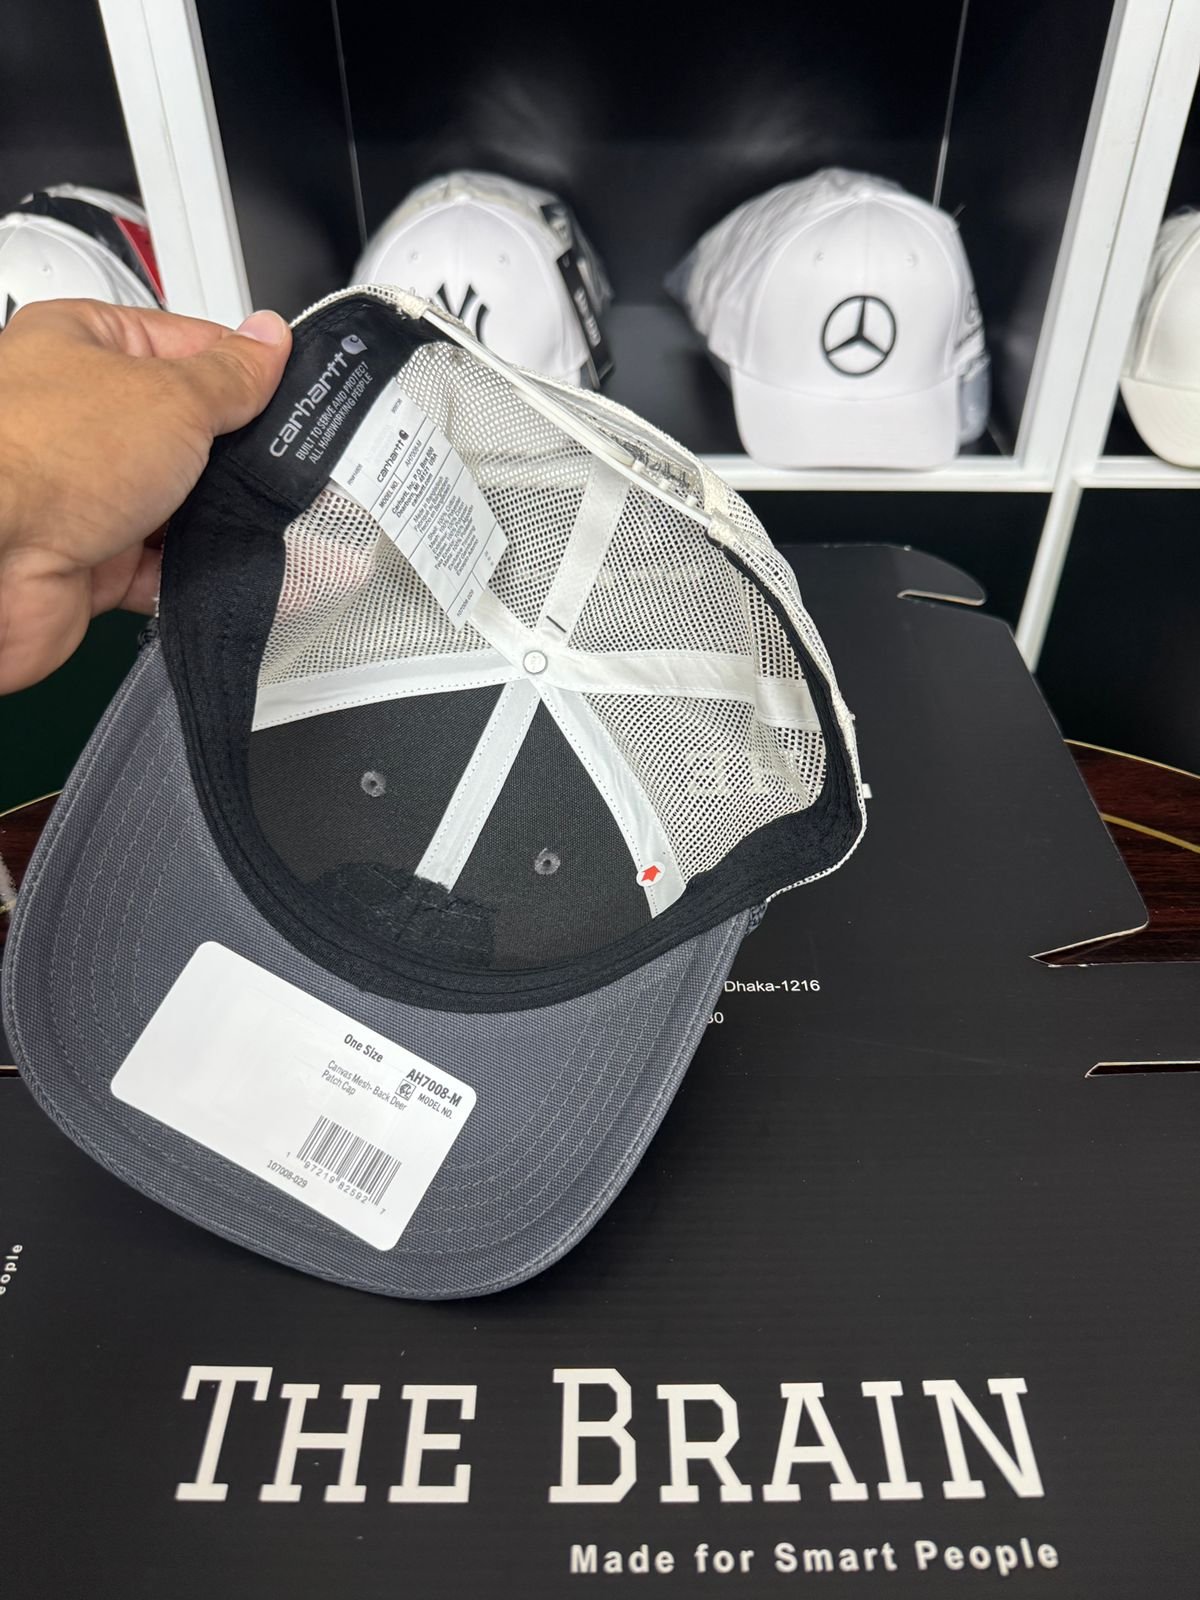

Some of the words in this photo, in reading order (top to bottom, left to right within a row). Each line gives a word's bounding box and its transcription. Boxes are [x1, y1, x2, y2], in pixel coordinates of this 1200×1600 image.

[270, 352, 348, 457] carhartt
[296, 437, 315, 460] BUILT
[310, 427, 322, 438] TO
[317, 405, 336, 429] SERVE
[332, 391, 347, 409] AND
[343, 362, 368, 393] PROTECT
[309, 449, 323, 464] ALL
[318, 398, 355, 449] HARDWORKING
[351, 372, 372, 400] PEOPLE
[377, 440, 404, 482] carhartt
[413, 469, 425, 481] P.O.
[420, 457, 428, 469] Box
[429, 453, 437, 466] USA
[413, 483, 420, 491] MI
[416, 466, 429, 482] 48121
[379, 490, 393, 508] MODEL
[390, 481, 399, 490] NO.
[412, 473, 433, 506] carhartt.com
[396, 490, 416, 518] Dearborn,
[413, 508, 424, 523] Made
[437, 512, 448, 526] 100%
[724, 980, 821, 992] Dhaka-1216
[344, 1034, 362, 1050] One
[363, 1045, 383, 1062] Size
[322, 1070, 342, 1087] Patch
[342, 1081, 356, 1095] Cap
[328, 1060, 352, 1080] Canvas
[352, 1074, 372, 1090] Mesh-
[373, 1086, 390, 1102] Back
[390, 1096, 407, 1110] Deer
[407, 1069, 462, 1106] AH7008-M
[418, 1093, 440, 1112] MODEL
[441, 1107, 452, 1119] NO.
[267, 1160, 307, 1188] 107008-029
[304, 1160, 335, 1183] 97219
[176, 1366, 477, 1503] THE
[549, 1369, 1044, 1503] BRAIN
[571, 1545, 674, 1573] Made
[695, 1544, 754, 1572] for
[775, 1543, 897, 1572] Smart
[915, 1538, 1058, 1575] People
